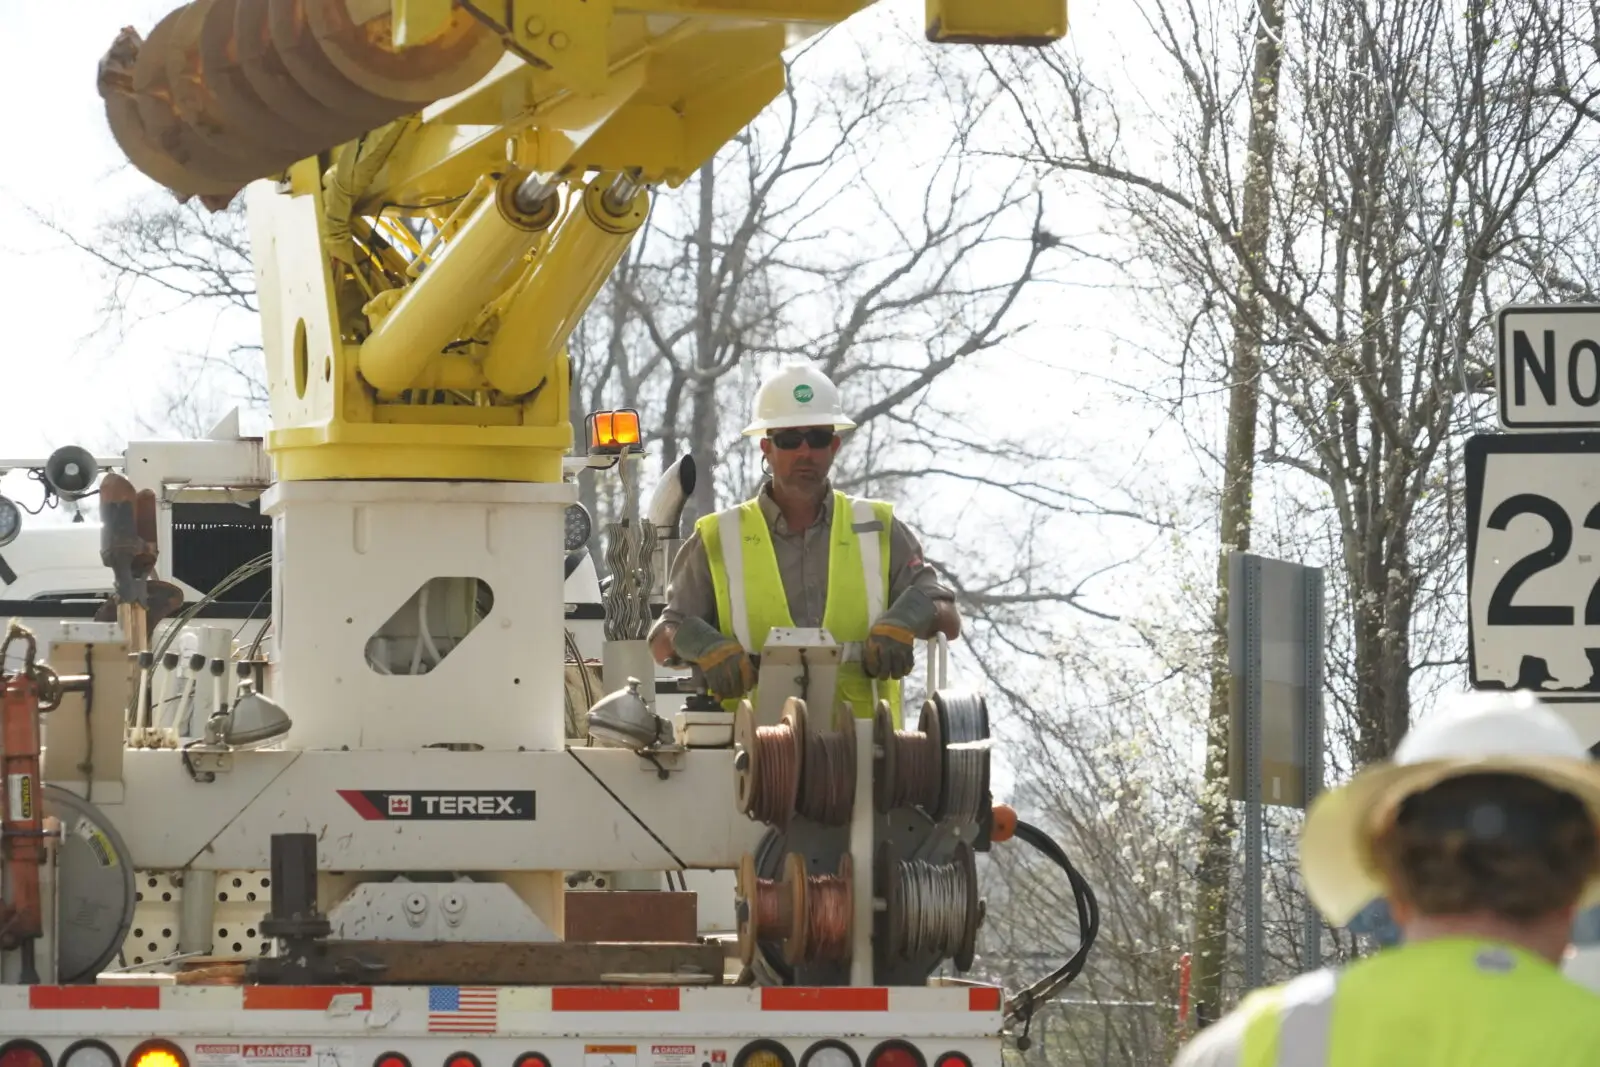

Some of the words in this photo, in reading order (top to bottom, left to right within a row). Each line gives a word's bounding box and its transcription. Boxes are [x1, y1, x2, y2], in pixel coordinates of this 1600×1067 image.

[1487, 493, 1600, 626] 2
[22, 778, 31, 817] STANLEY
[421, 796, 516, 814] TEREX
[257, 1046, 309, 1057] DANGER
[660, 1046, 694, 1054] DANGER
